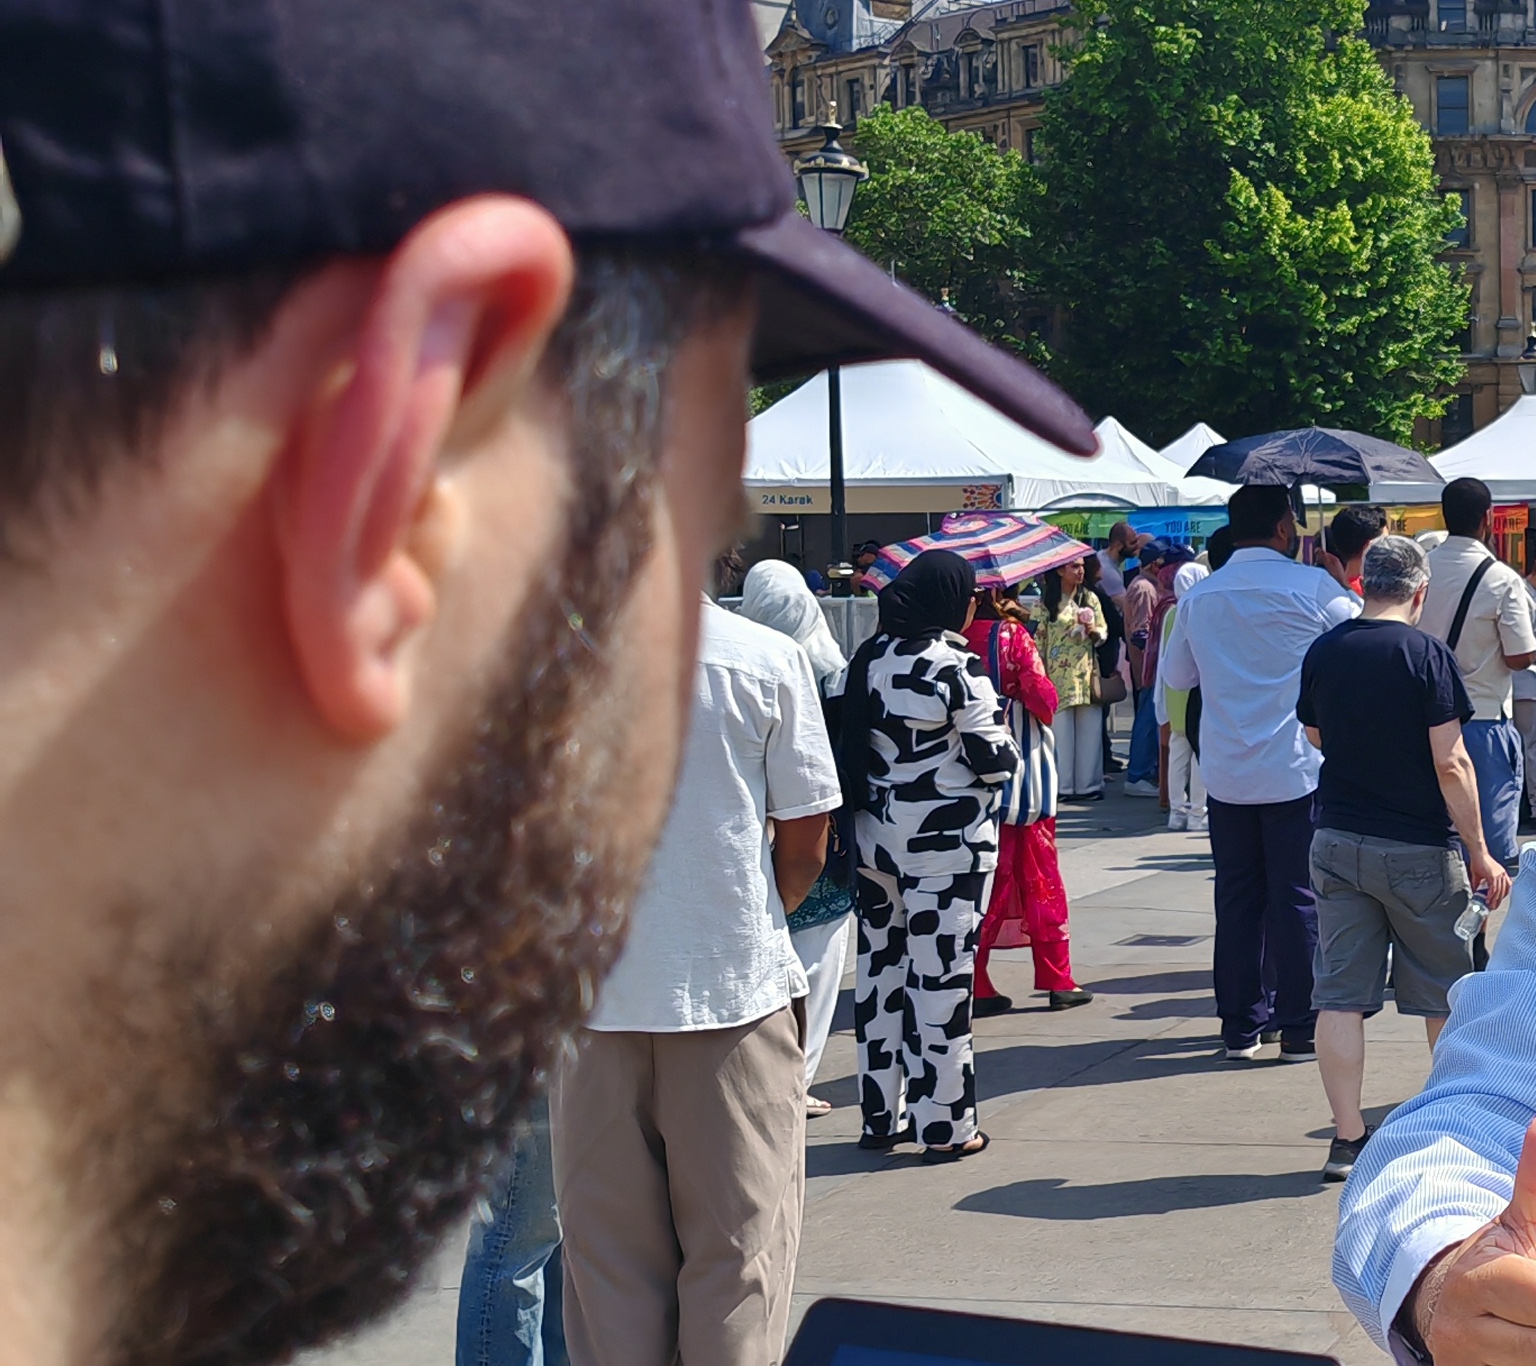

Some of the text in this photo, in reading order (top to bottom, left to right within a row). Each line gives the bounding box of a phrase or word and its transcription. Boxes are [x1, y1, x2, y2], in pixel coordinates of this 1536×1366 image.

[762, 494, 814, 505] 24 Karak
[1164, 521, 1201, 534] YOU ARE
